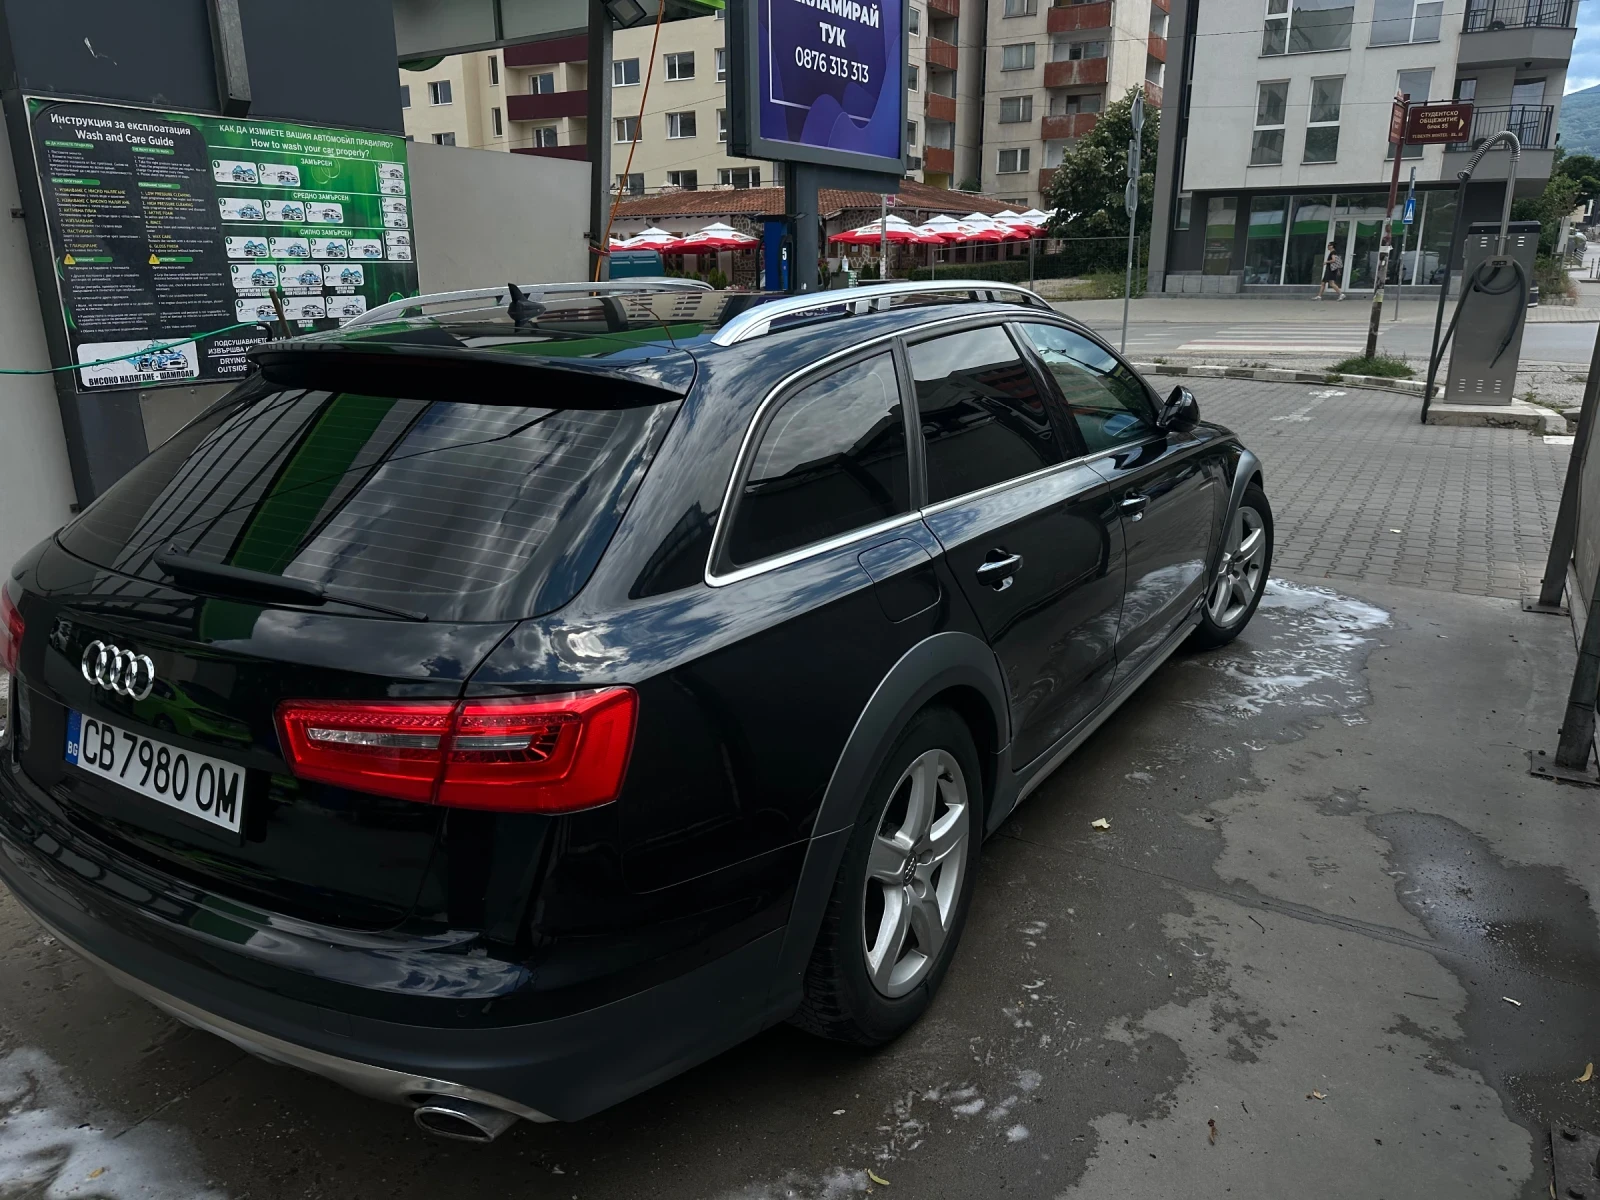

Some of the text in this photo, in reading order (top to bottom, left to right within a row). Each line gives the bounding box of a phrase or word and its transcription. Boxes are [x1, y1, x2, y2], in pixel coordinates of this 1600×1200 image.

[820, 22, 846, 48] ТУК
[795, 46, 869, 83] 0876 313 313
[50, 114, 112, 128] Инструкция
[127, 122, 191, 135] експлоатация
[75, 130, 174, 147] Wash and Care Guide
[236, 126, 247, 134] ДА
[250, 128, 284, 138] ИЗМИЕТЕ
[286, 130, 311, 140] ВАШИЯ
[314, 133, 354, 145] АВТОМОБИЛ
[356, 138, 394, 148] ПРАВИЛНО?
[251, 139, 270, 148] How
[282, 142, 302, 151] wash
[304, 145, 320, 153] your
[336, 148, 369, 158] properly?
[300, 158, 333, 167] ЗАМЪРСЕН
[782, 248, 787, 260] 5
[89, 376, 118, 386] ВИСОКО
[120, 373, 155, 384] НАЛЯГАНЕ
[160, 370, 194, 379] ШАМПОАН
[218, 365, 247, 373] OUTSIDE
[67, 741, 79, 756] BG
[119, 732, 189, 801] 7980
